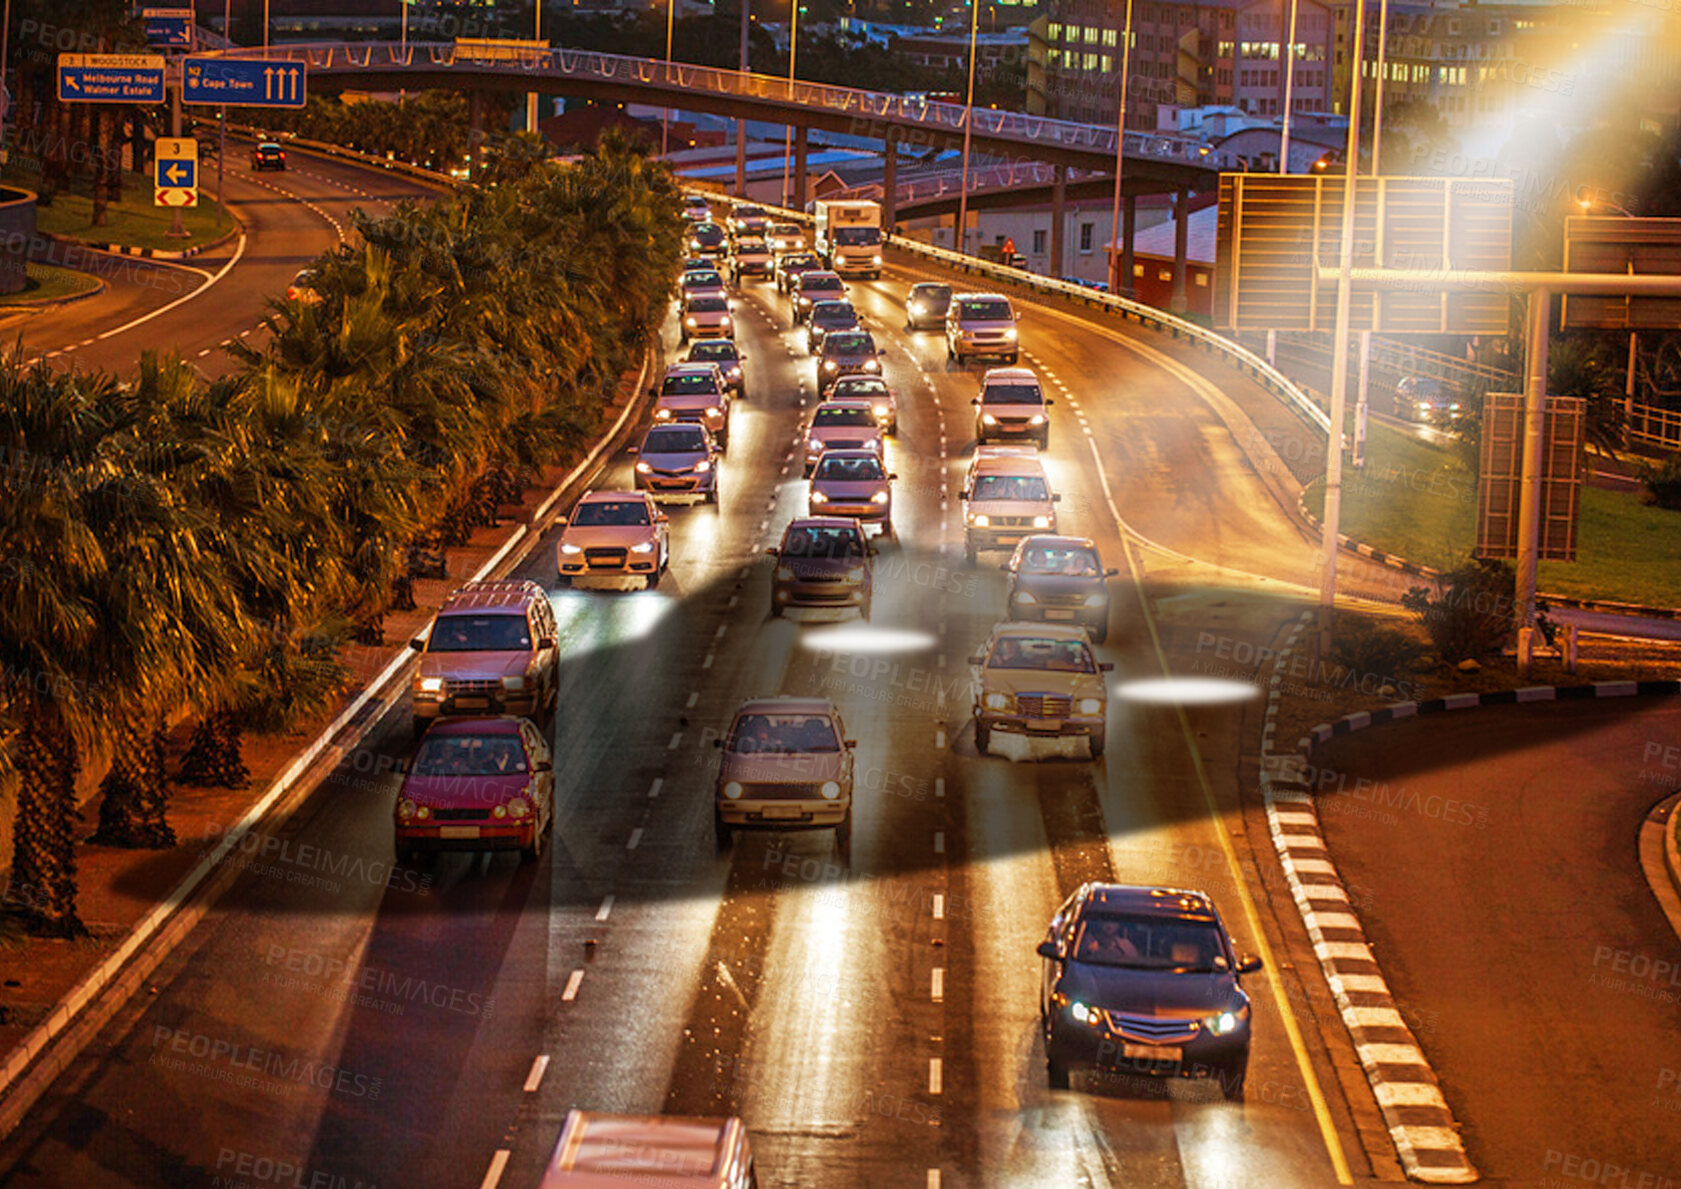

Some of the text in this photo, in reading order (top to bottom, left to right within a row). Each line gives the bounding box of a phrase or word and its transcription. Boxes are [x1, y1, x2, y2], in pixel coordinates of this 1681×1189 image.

[91, 57, 148, 66] WOODSTOCK
[188, 66, 202, 76] N2
[82, 73, 159, 85] Melbourne Road
[202, 78, 226, 89] Cape
[229, 78, 254, 89] Town
[83, 85, 152, 95] Walmer Estate
[173, 142, 180, 155] 3
